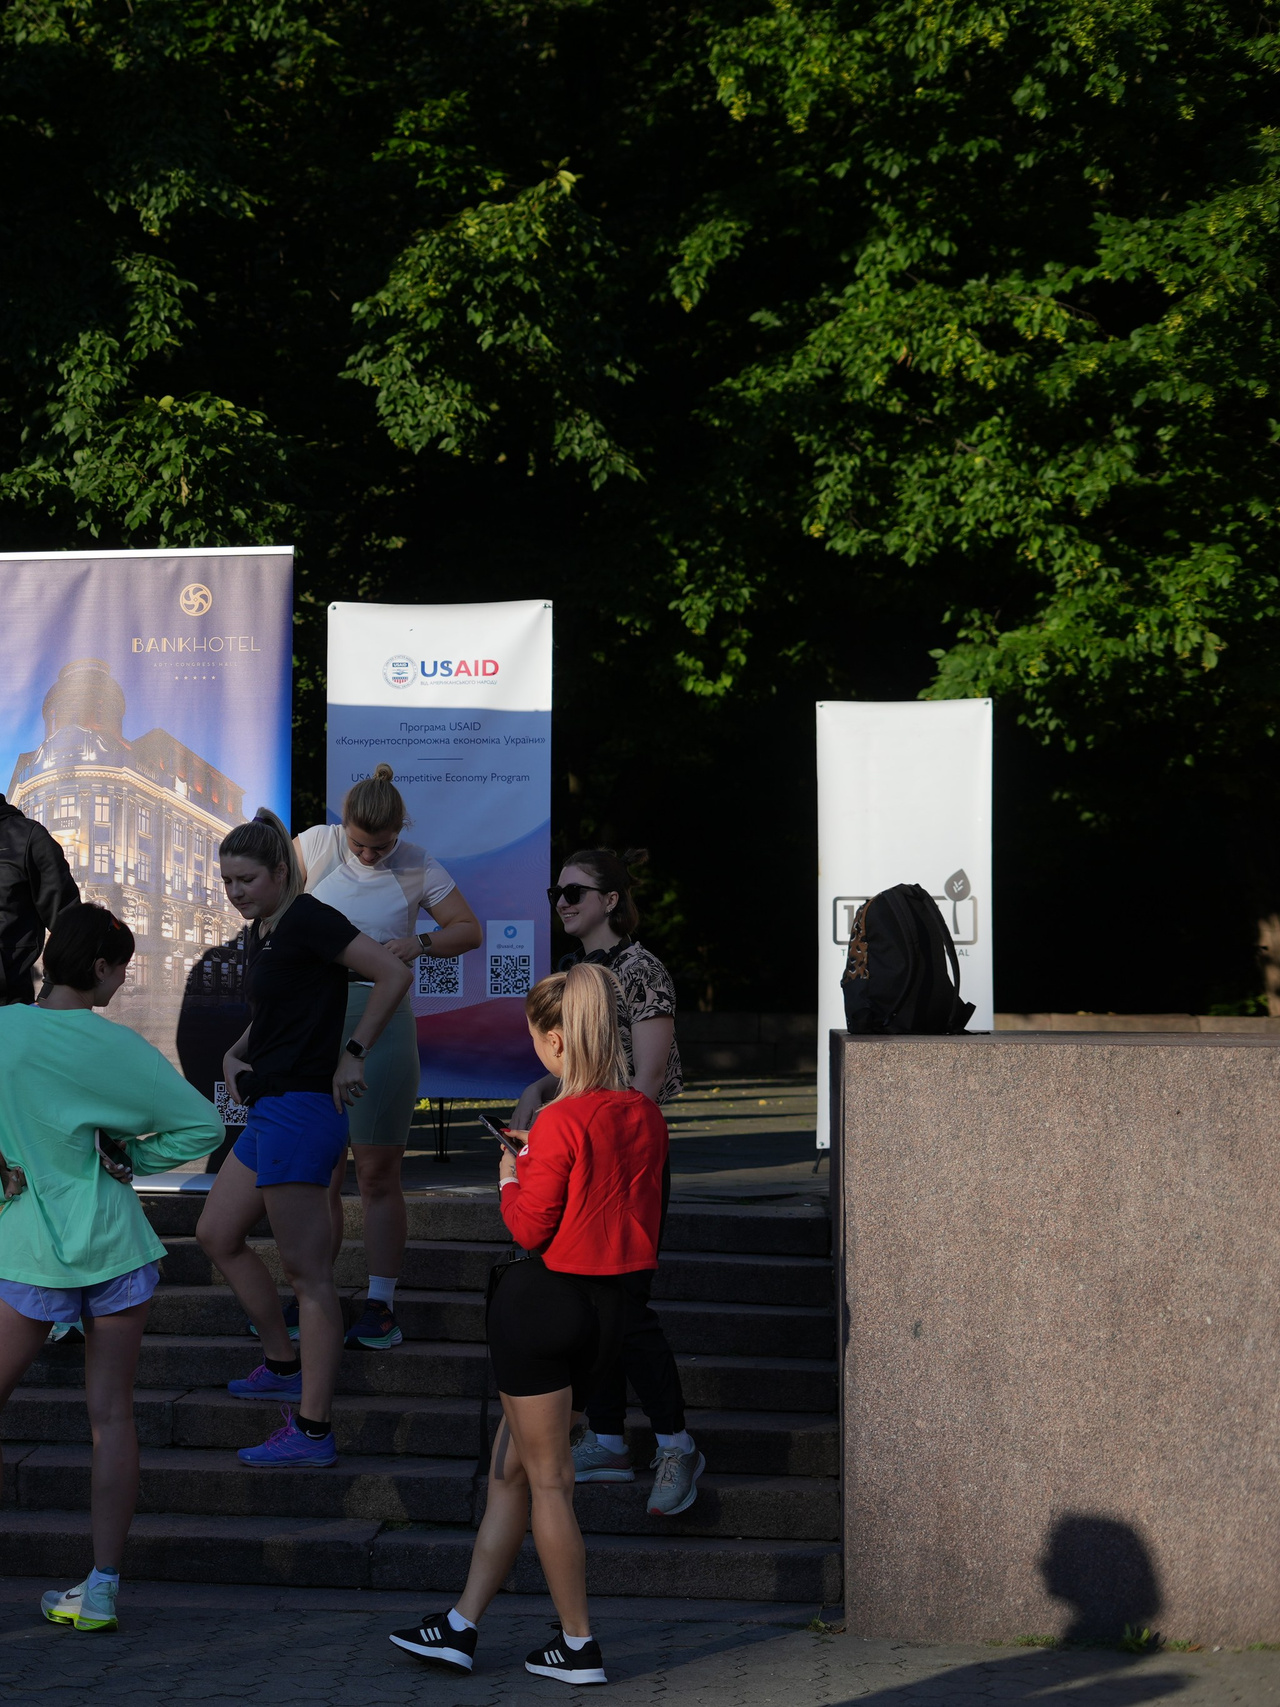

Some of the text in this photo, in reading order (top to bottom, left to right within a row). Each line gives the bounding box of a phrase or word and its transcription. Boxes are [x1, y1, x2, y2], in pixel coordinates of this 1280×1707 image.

[131, 636, 261, 653] BANKHOTEL
[420, 660, 499, 677] USAID
[399, 722, 482, 734] Програма USAID
[335, 735, 546, 747] «Конкурентоспроможна економіка України»
[445, 773, 488, 784] Economy
[491, 773, 530, 784] Program
